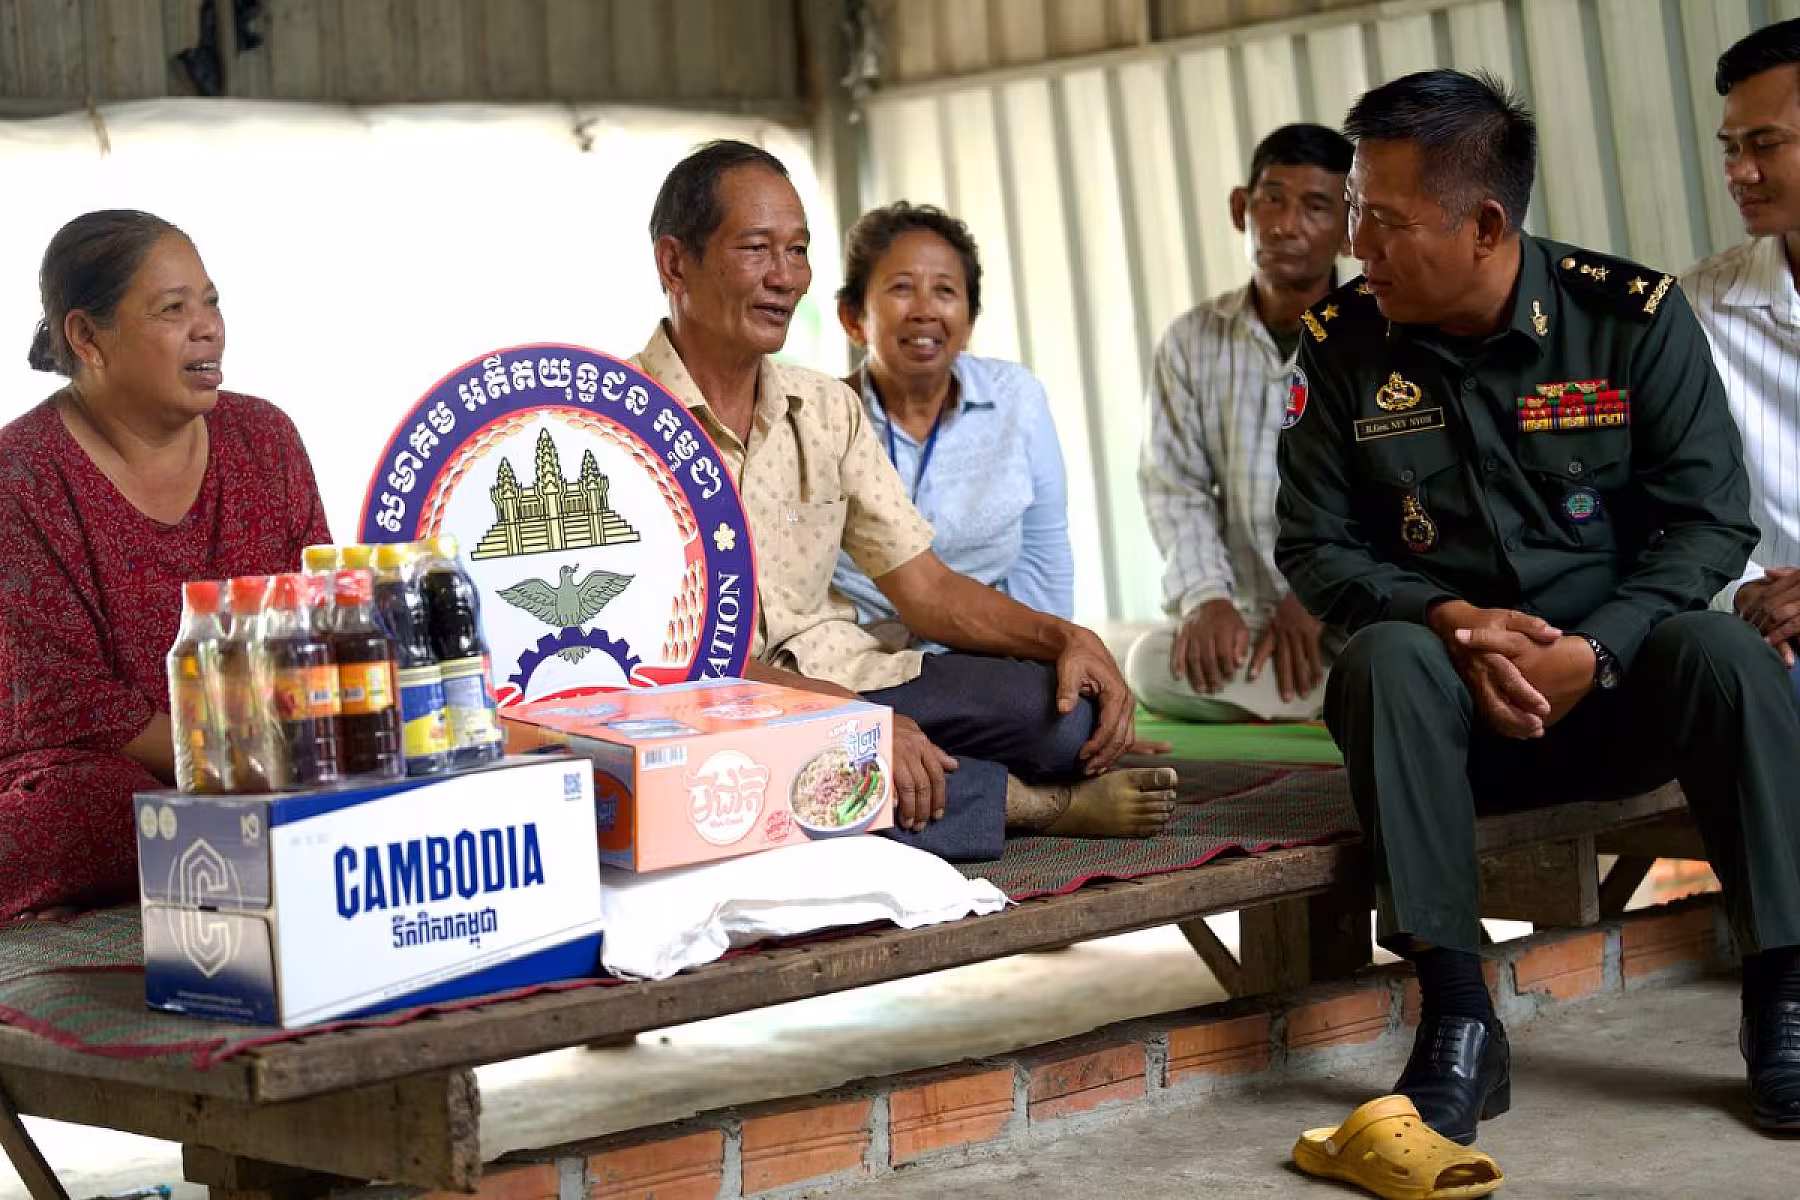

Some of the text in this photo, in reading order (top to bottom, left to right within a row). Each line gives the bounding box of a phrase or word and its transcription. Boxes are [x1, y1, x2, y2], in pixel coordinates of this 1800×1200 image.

[375, 354, 722, 532] សមាគម អតីតយុទ្ធជន កម្ពុជា
[333, 822, 544, 920] CAMBODIA
